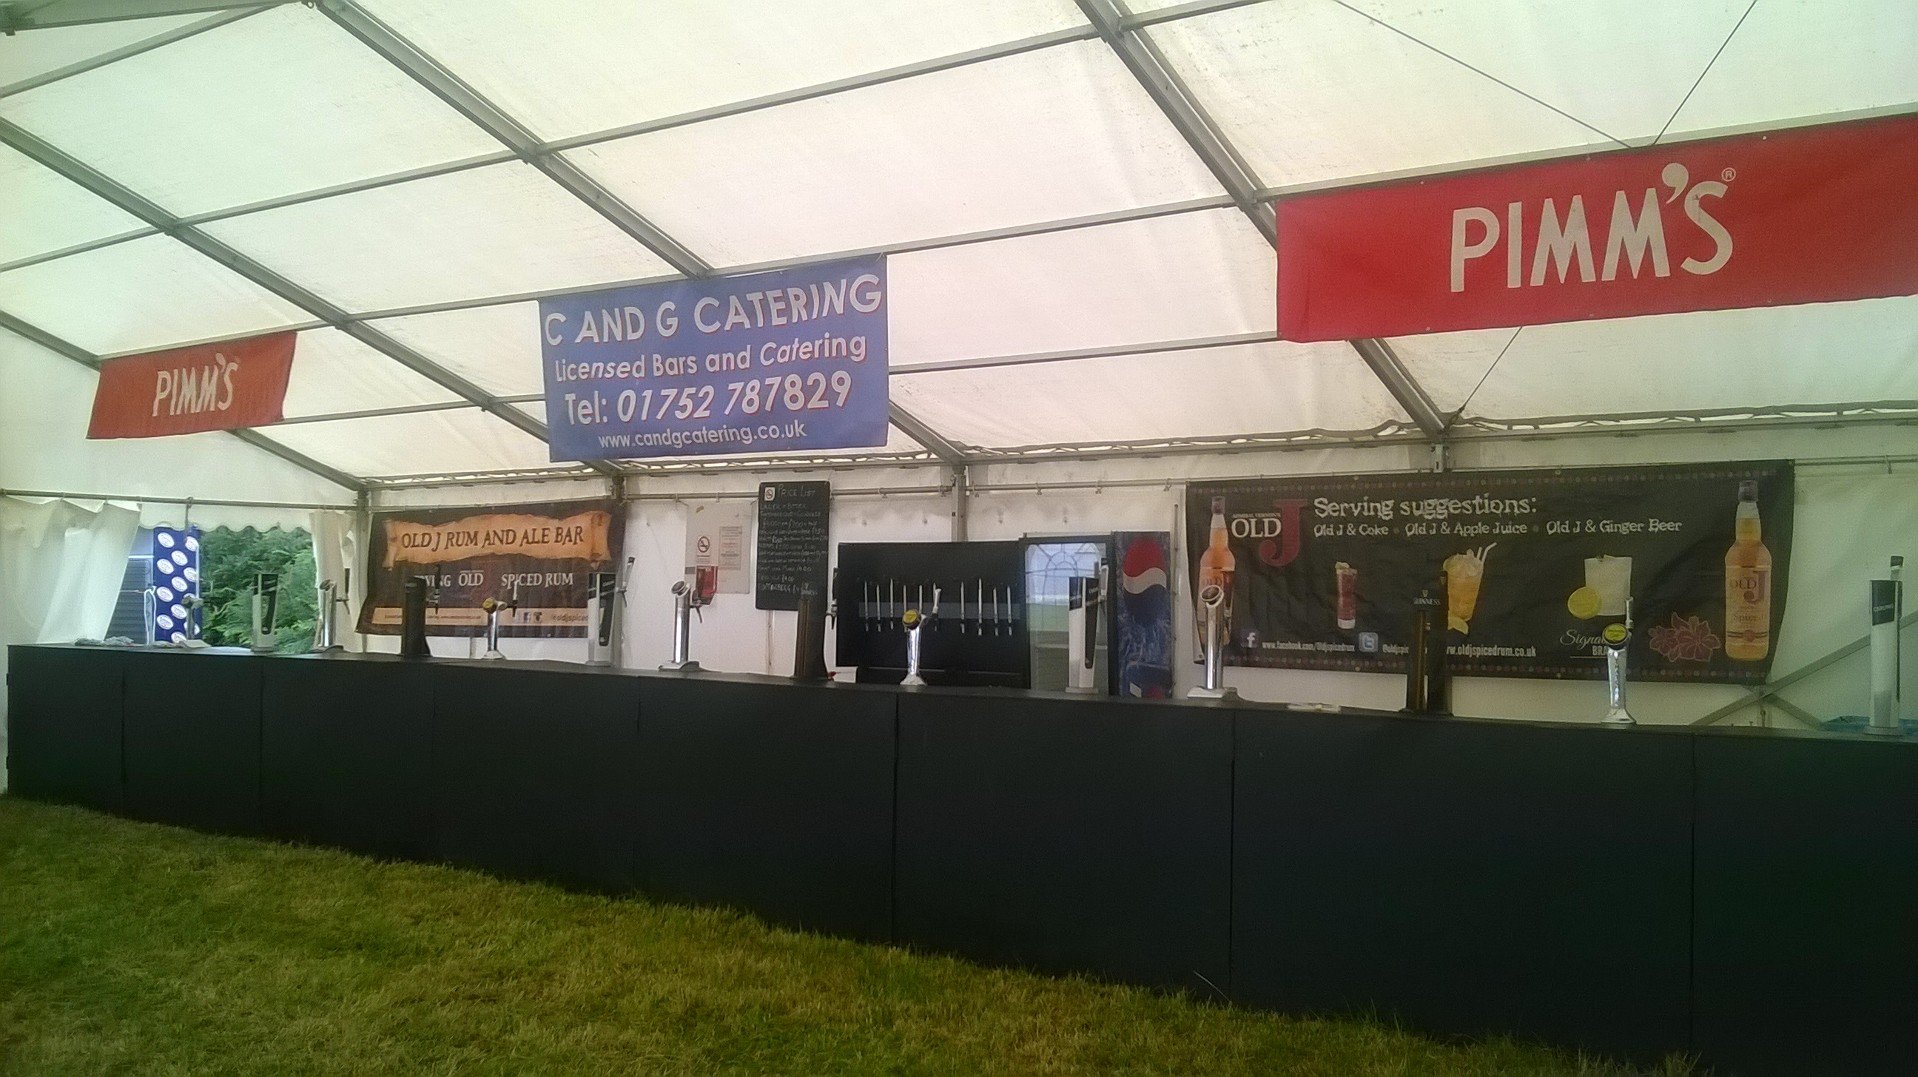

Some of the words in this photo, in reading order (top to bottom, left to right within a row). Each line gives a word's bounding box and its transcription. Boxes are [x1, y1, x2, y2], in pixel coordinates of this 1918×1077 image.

[545, 313, 566, 346] C
[574, 306, 646, 344] AND
[656, 301, 679, 337] G
[694, 274, 882, 334] CATERING
[555, 355, 646, 383] Licensed
[652, 353, 699, 377] Bars
[705, 345, 751, 372] and
[760, 331, 867, 367] Catering
[565, 391, 608, 425] Tel:
[616, 385, 715, 423] 01752
[723, 371, 852, 415] 787829
[598, 420, 807, 450] www.candgcatering.co.uk
[1313, 496, 1395, 521] Serving
[1399, 493, 1537, 520] suggestions:
[401, 531, 433, 549] OLD
[431, 532, 442, 552] J
[444, 530, 479, 550] RUM
[481, 528, 517, 549] AND
[519, 527, 551, 547] ALE
[554, 525, 584, 545] BAR
[1231, 518, 1282, 538] OLD
[1259, 499, 1307, 567] J
[1313, 524, 1335, 538] Old
[1336, 524, 1344, 536] J
[1346, 523, 1357, 536] &
[1359, 524, 1389, 536] Coke
[1404, 522, 1427, 537] Old
[1429, 522, 1437, 535] J
[1440, 521, 1450, 534] &
[1453, 521, 1490, 537] Apple
[1492, 521, 1528, 535] Juice
[1546, 520, 1570, 535] Old
[1572, 520, 1582, 533] J
[1584, 518, 1597, 533] &
[1599, 519, 1645, 535] Ginger
[1647, 518, 1683, 533] Beer
[458, 573, 484, 588] OLD
[501, 572, 543, 589] SPICED
[544, 572, 575, 589] RUM
[1560, 629, 1607, 650] Signa
